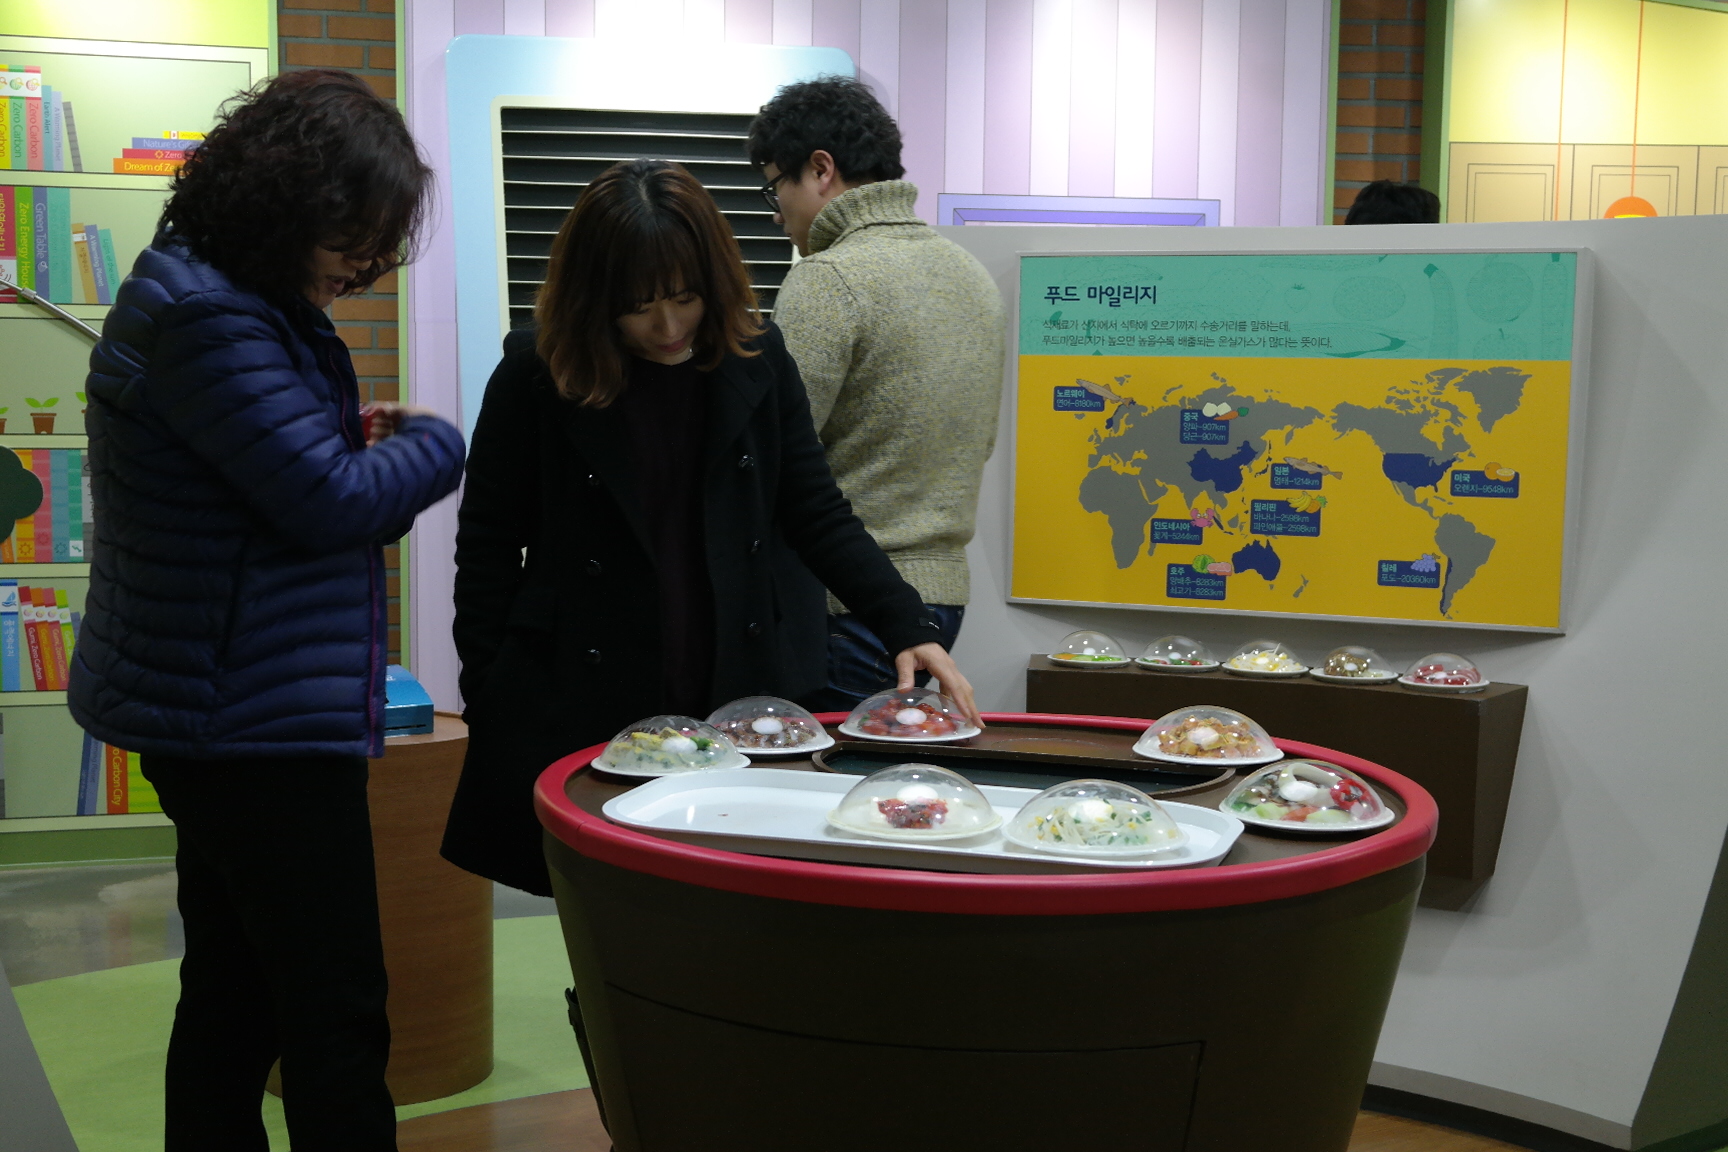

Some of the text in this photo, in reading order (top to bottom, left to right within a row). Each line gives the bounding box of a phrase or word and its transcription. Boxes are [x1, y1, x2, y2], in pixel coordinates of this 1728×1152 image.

[13, 102, 23, 157] Zero Carbon
[29, 103, 40, 158] Zero Carbon
[144, 139, 176, 148] Nature's
[124, 162, 153, 171] Dream
[154, 162, 163, 171] of
[19, 203, 29, 224] Zero
[35, 203, 46, 258] Green Table
[18, 226, 31, 258] Energy
[1044, 285, 1156, 307] 푸드 마일리지
[1042, 320, 1290, 332] 식재료가 산지에서 식탁에 오르기까지 수송거리를 말하는데,
[1042, 335, 1332, 348] 푸드마일리지가 높으면 높을수록 배출되는 온실가스가 많다는 뜻이다.
[1056, 390, 1085, 398] 노르웨이
[1184, 412, 1199, 421] 중국
[1274, 466, 1289, 475] 일본
[1454, 473, 1470, 482] 미국
[1254, 503, 1276, 512] 필리핀
[1154, 522, 1190, 531] 인도네시아
[1170, 567, 1185, 575] 호주
[1381, 563, 1397, 572] 칠레
[56, 647, 64, 659] Zero
[34, 659, 43, 680] Carbon
[46, 660, 55, 681] Carbon
[58, 660, 67, 681] Carbon
[112, 756, 122, 787] Carbon
[111, 789, 123, 805] City
